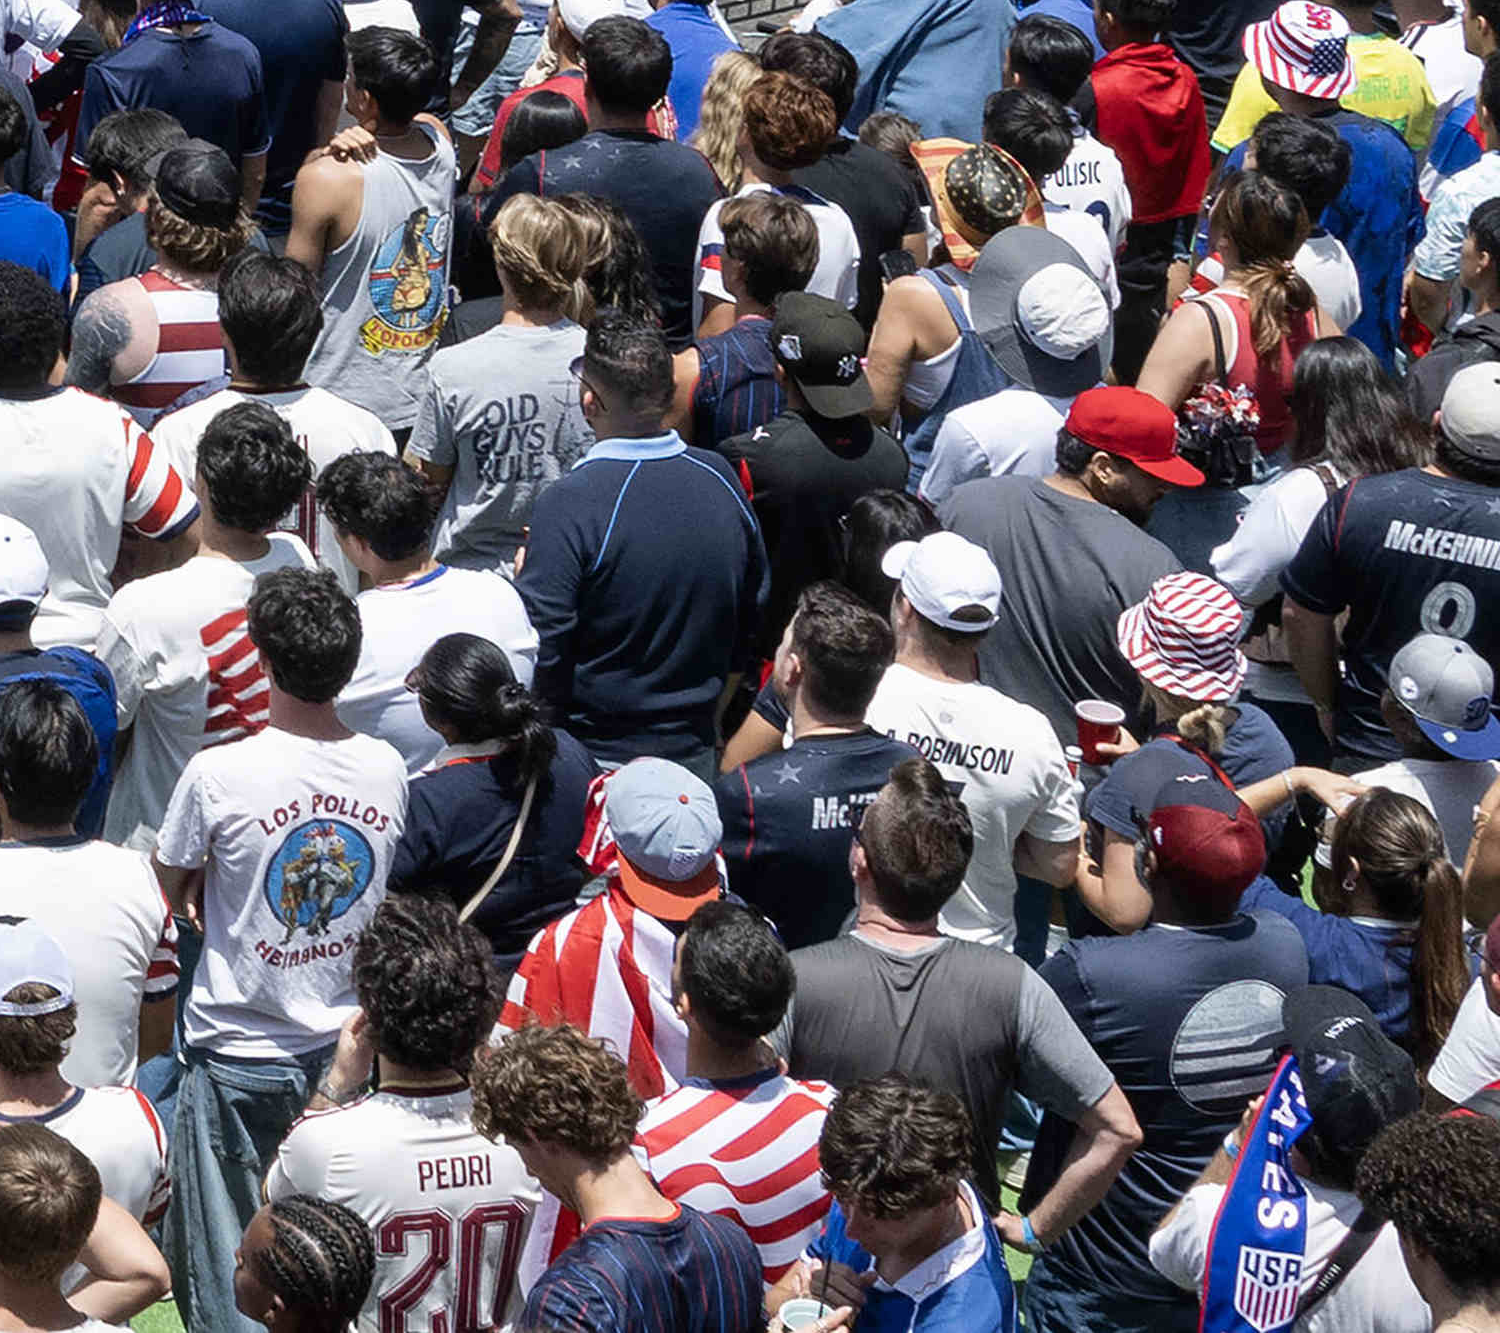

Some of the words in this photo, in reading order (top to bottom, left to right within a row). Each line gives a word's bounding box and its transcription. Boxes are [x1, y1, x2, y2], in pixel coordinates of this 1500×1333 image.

[484, 393, 539, 431] OLD
[475, 422, 546, 457] GUYS
[259, 799, 300, 835] LOS
[310, 792, 389, 831] POLLOS
[417, 1153, 493, 1192] PEDRI
[376, 1200, 530, 1333] 20
[1244, 1249, 1302, 1288] USA
